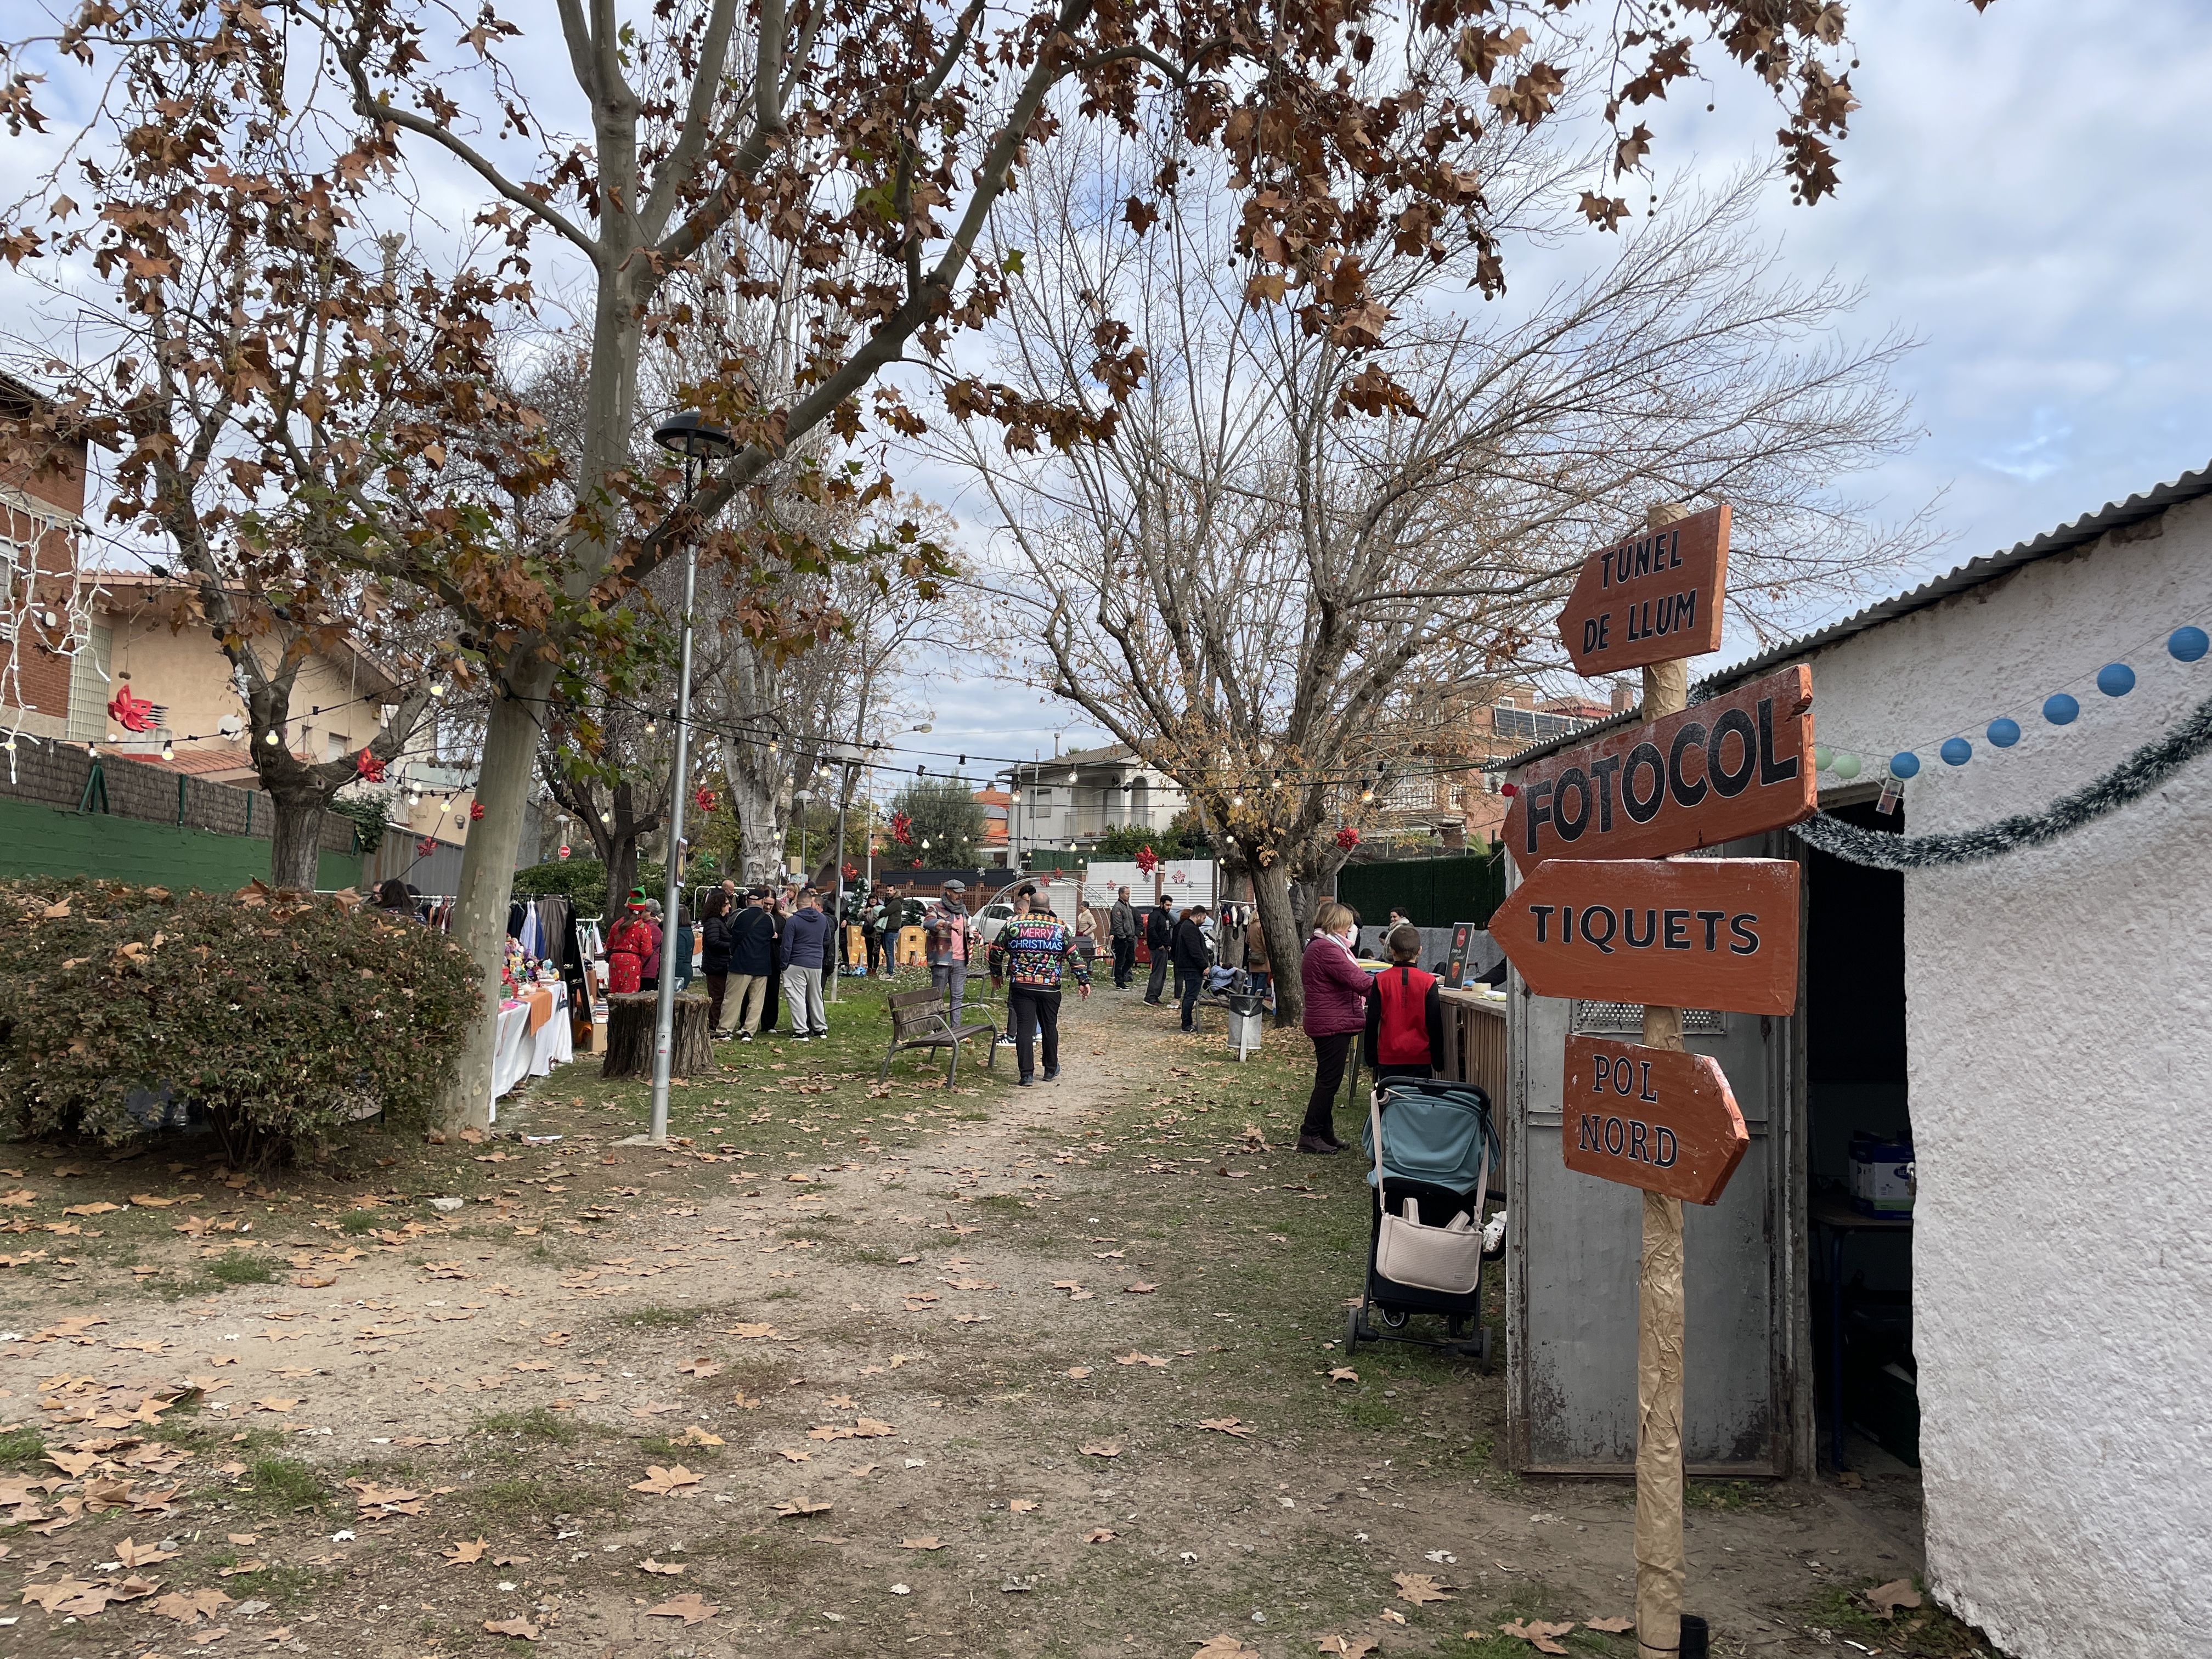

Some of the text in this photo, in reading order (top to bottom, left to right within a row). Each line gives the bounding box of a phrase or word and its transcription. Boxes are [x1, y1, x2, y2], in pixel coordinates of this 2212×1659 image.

[1600, 530, 1683, 590] TUNEL
[1583, 588, 1697, 655] DE LLUM
[1525, 697, 1799, 854] FOTOCOL
[1011, 940, 1063, 950] CHRISTMAS
[1020, 928, 1054, 940] MERRY
[1528, 905, 1760, 956] TIQUETS
[1592, 1054, 1658, 1104] POL
[1578, 1113, 1679, 1169] NORD
